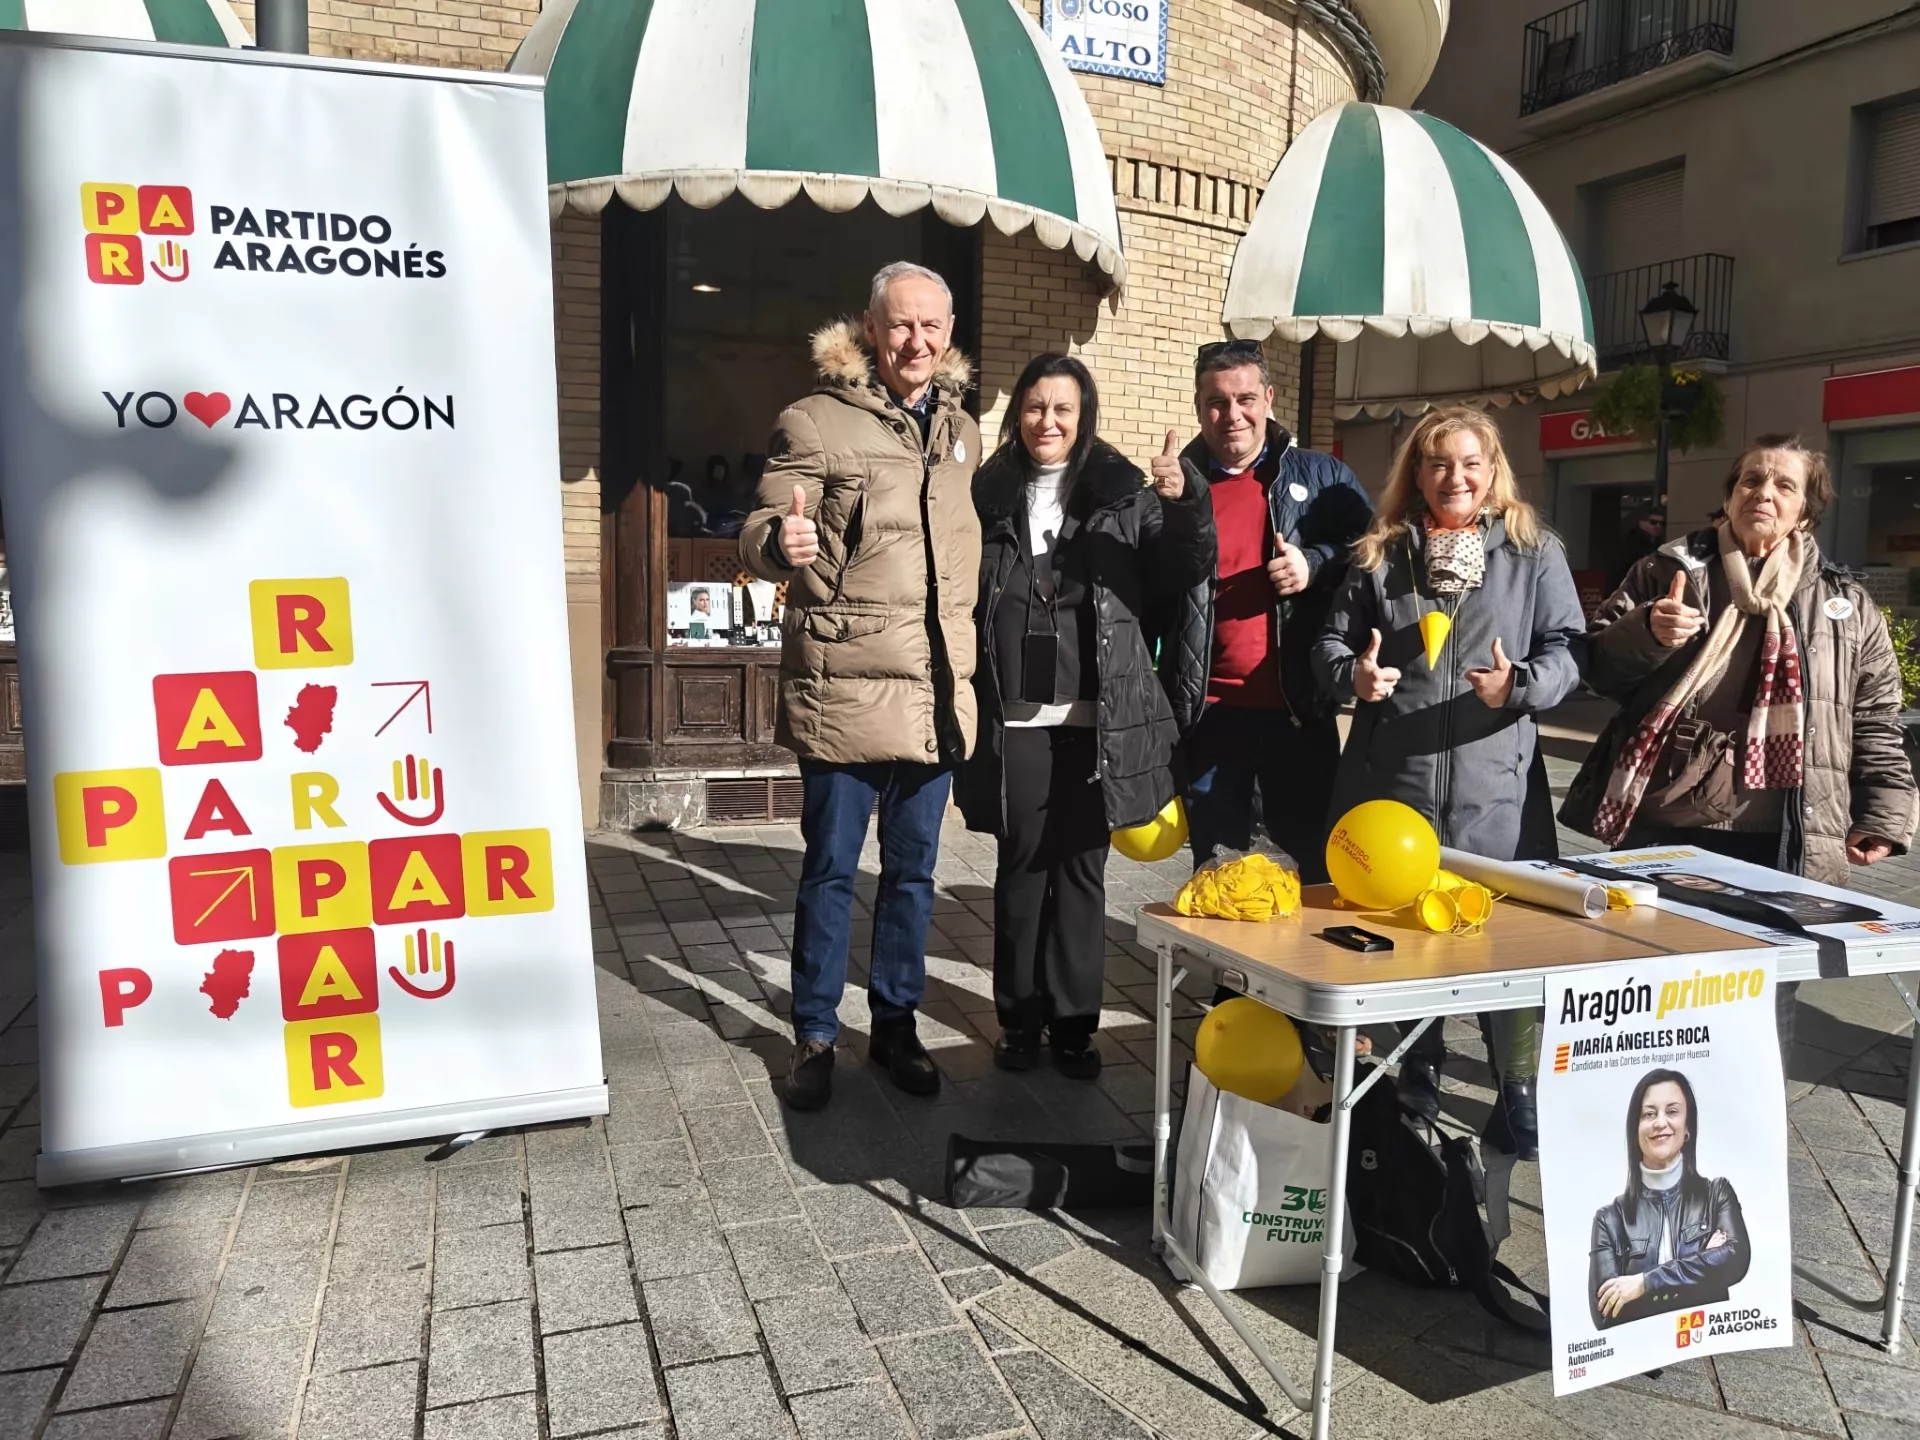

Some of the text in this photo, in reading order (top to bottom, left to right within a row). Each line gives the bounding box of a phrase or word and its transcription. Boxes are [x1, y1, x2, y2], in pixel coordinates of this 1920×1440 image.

[1089, 0, 1149, 21] COSO
[1060, 34, 1151, 66] ALTO
[210, 205, 391, 245] PARTIDO
[213, 241, 447, 279] ARAGONÉS
[102, 386, 456, 431] YO ARAGÓN
[1560, 968, 1765, 1026] Aragón primero
[1572, 1026, 1710, 1057] MARÍA ÁNGELES ROCA
[1571, 1059, 1603, 1072] Candidata
[1609, 1058, 1619, 1068] las
[1620, 1056, 1640, 1067] Cortes
[1641, 1054, 1650, 1064] de
[1651, 1052, 1674, 1065] Aragón
[1675, 1052, 1686, 1063] por
[1687, 1049, 1710, 1060] Huesca
[1266, 1228, 1324, 1244] FUTUR
[1708, 1308, 1761, 1325] PARTIDO
[1708, 1316, 1778, 1337] ARAGONÉS
[1567, 1336, 1607, 1354] Elecciones
[1568, 1347, 1614, 1367] Autonómicas
[1568, 1367, 1587, 1380] 2026
